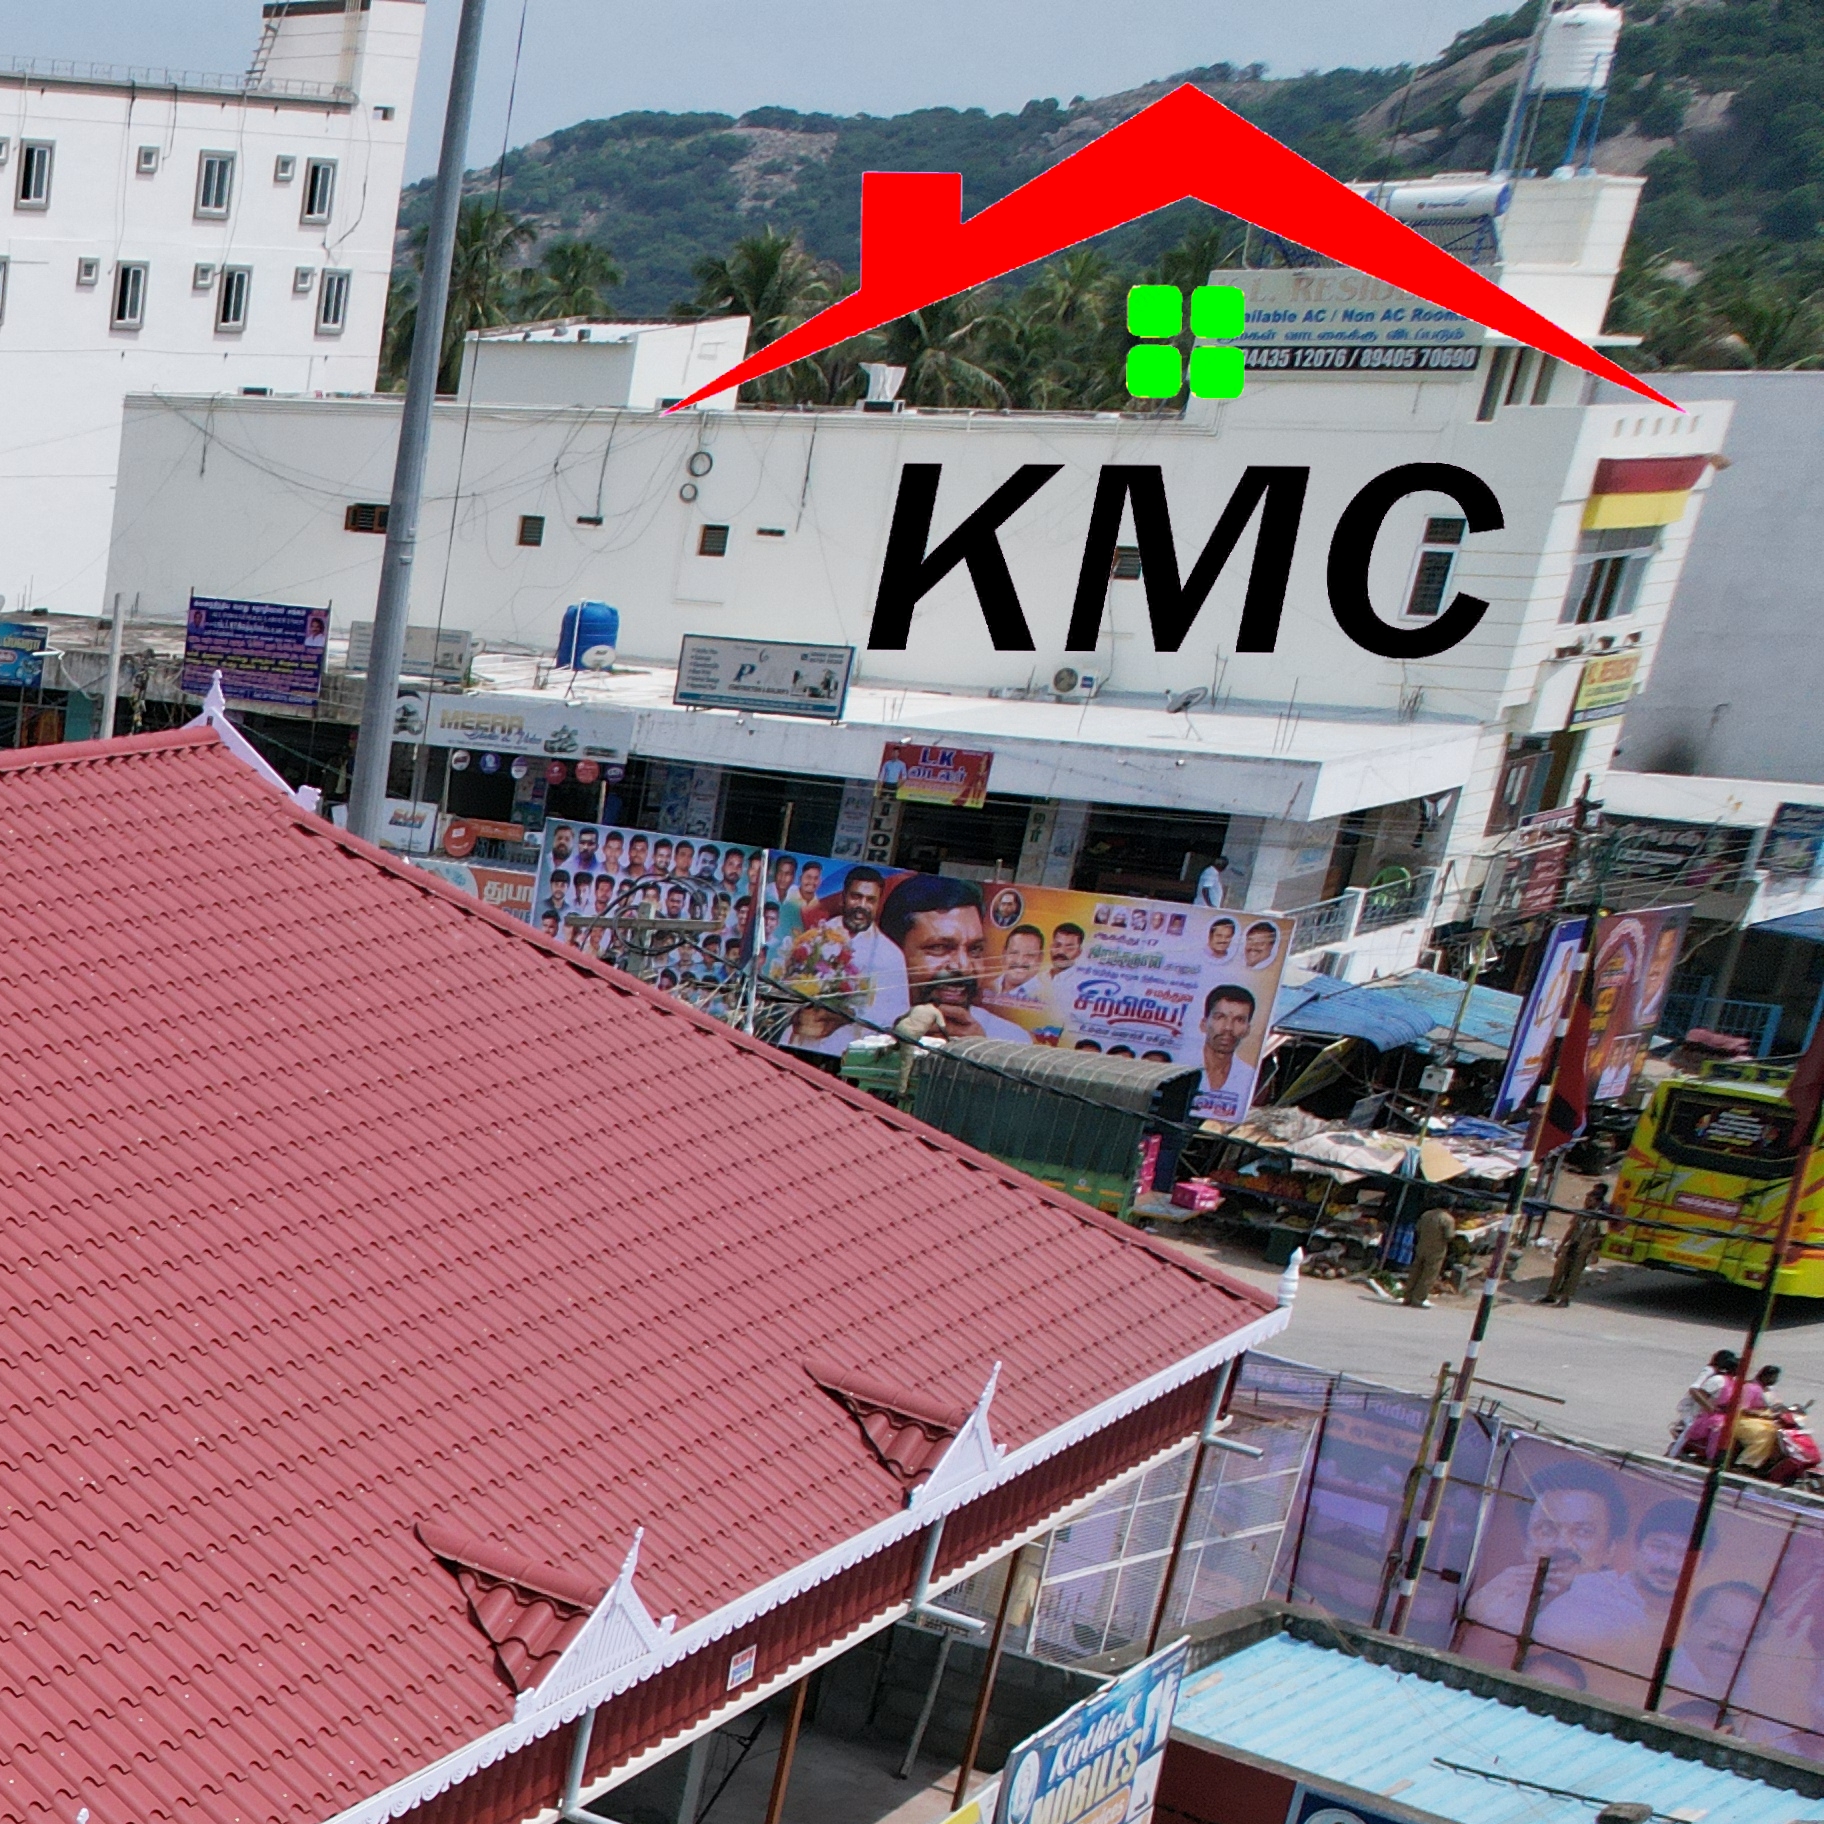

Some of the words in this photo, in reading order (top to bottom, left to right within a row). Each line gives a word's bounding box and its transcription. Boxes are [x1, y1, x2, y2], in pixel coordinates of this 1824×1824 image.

[1243, 309, 1297, 324] ailable
[1302, 310, 1326, 323] AC
[1341, 309, 1375, 323] Non
[1380, 308, 1406, 322] AC
[1293, 348, 1348, 368] 12076
[1360, 348, 1418, 368] 89405
[1419, 348, 1476, 368] 70690
[920, 747, 955, 768] L.K
[483, 880, 535, 905] துபா
[1073, 979, 1189, 1026] சிற்பியே!
